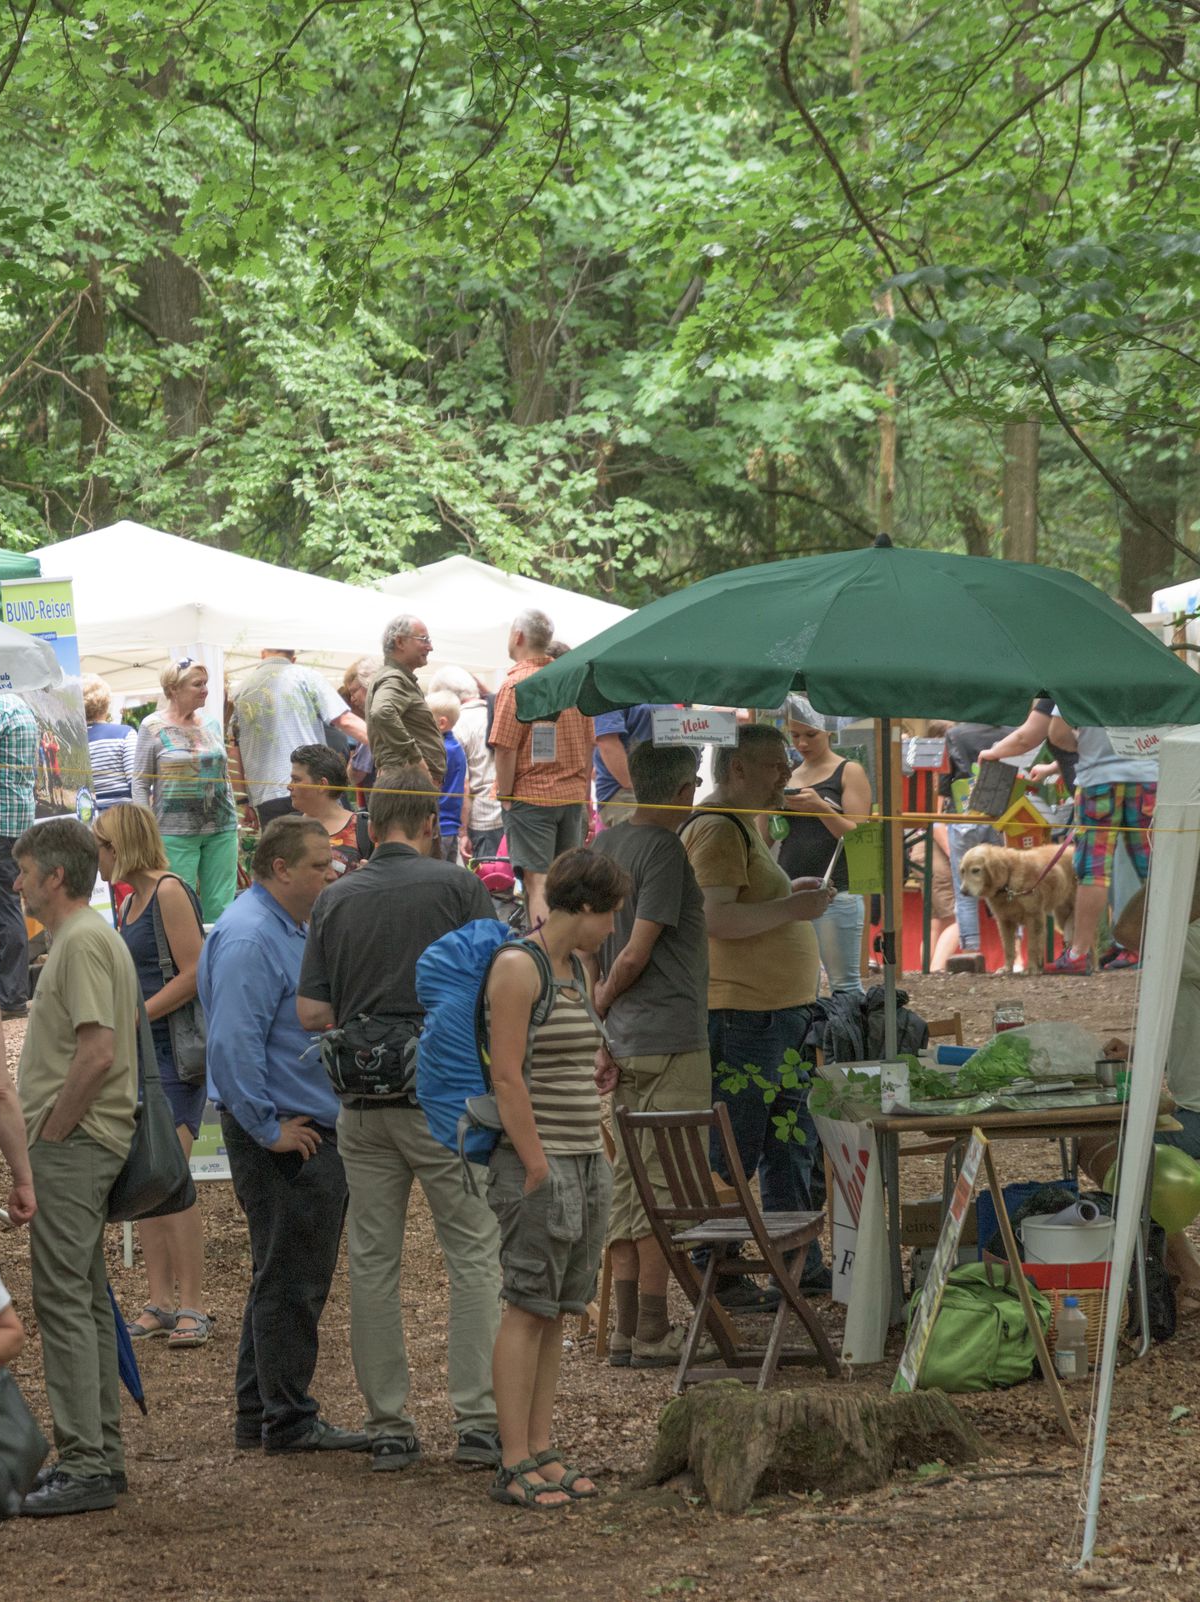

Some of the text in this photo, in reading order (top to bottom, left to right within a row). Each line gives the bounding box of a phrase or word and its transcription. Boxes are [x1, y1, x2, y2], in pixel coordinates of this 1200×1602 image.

[6, 597, 72, 623] BUND-Reisen
[681, 718, 710, 735] Nein
[1135, 734, 1160, 752] Nein
